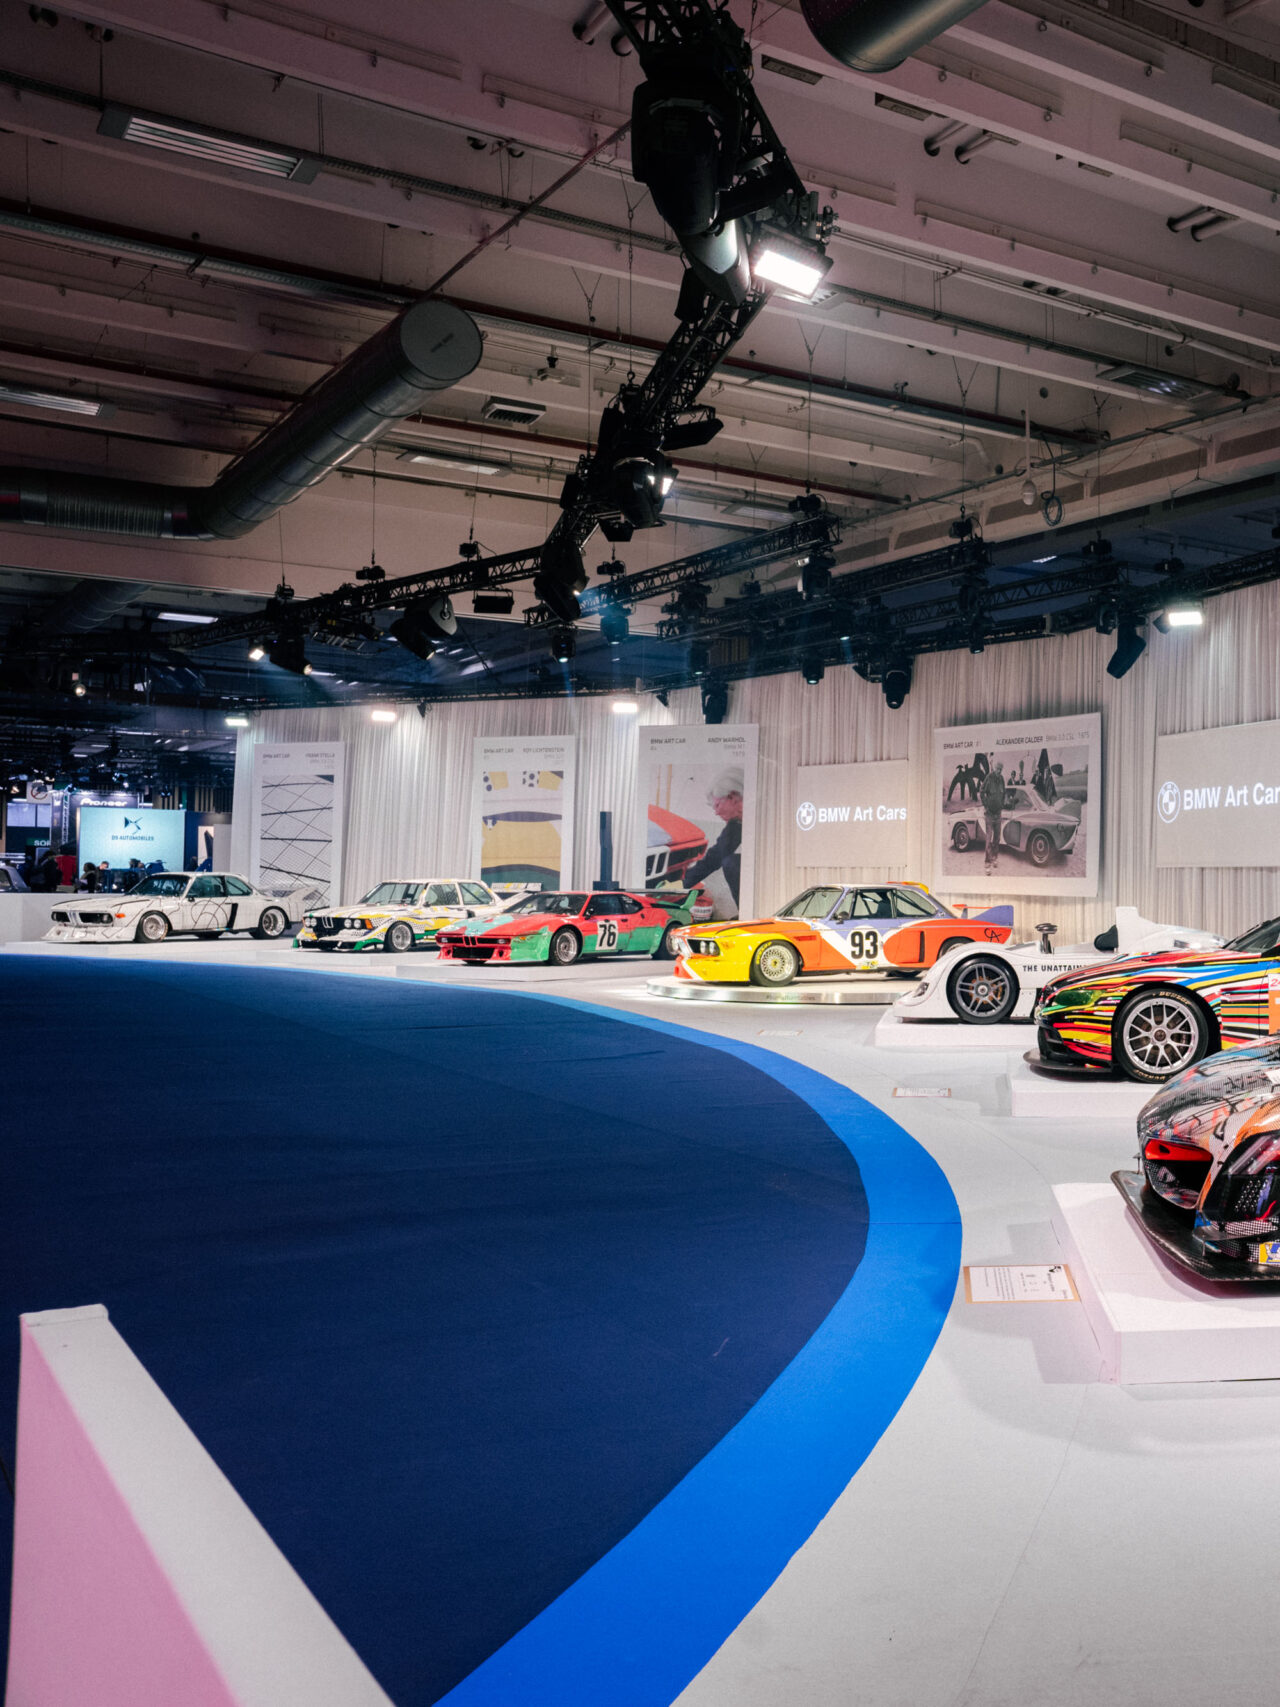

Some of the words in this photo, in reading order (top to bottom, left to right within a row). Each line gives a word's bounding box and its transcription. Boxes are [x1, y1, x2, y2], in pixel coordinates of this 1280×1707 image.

[996, 736, 1025, 746] ALEXANDER
[1025, 735, 1044, 744] CALDER
[80, 798, 128, 807] Pioneer
[1183, 786, 1222, 811] BMW
[1224, 784, 1249, 808] Art
[818, 806, 851, 823] BMW
[853, 805, 874, 822] Art
[876, 804, 907, 821] Cars
[598, 923, 617, 947] 76
[850, 930, 879, 960] 93
[1023, 964, 1038, 972] THE
